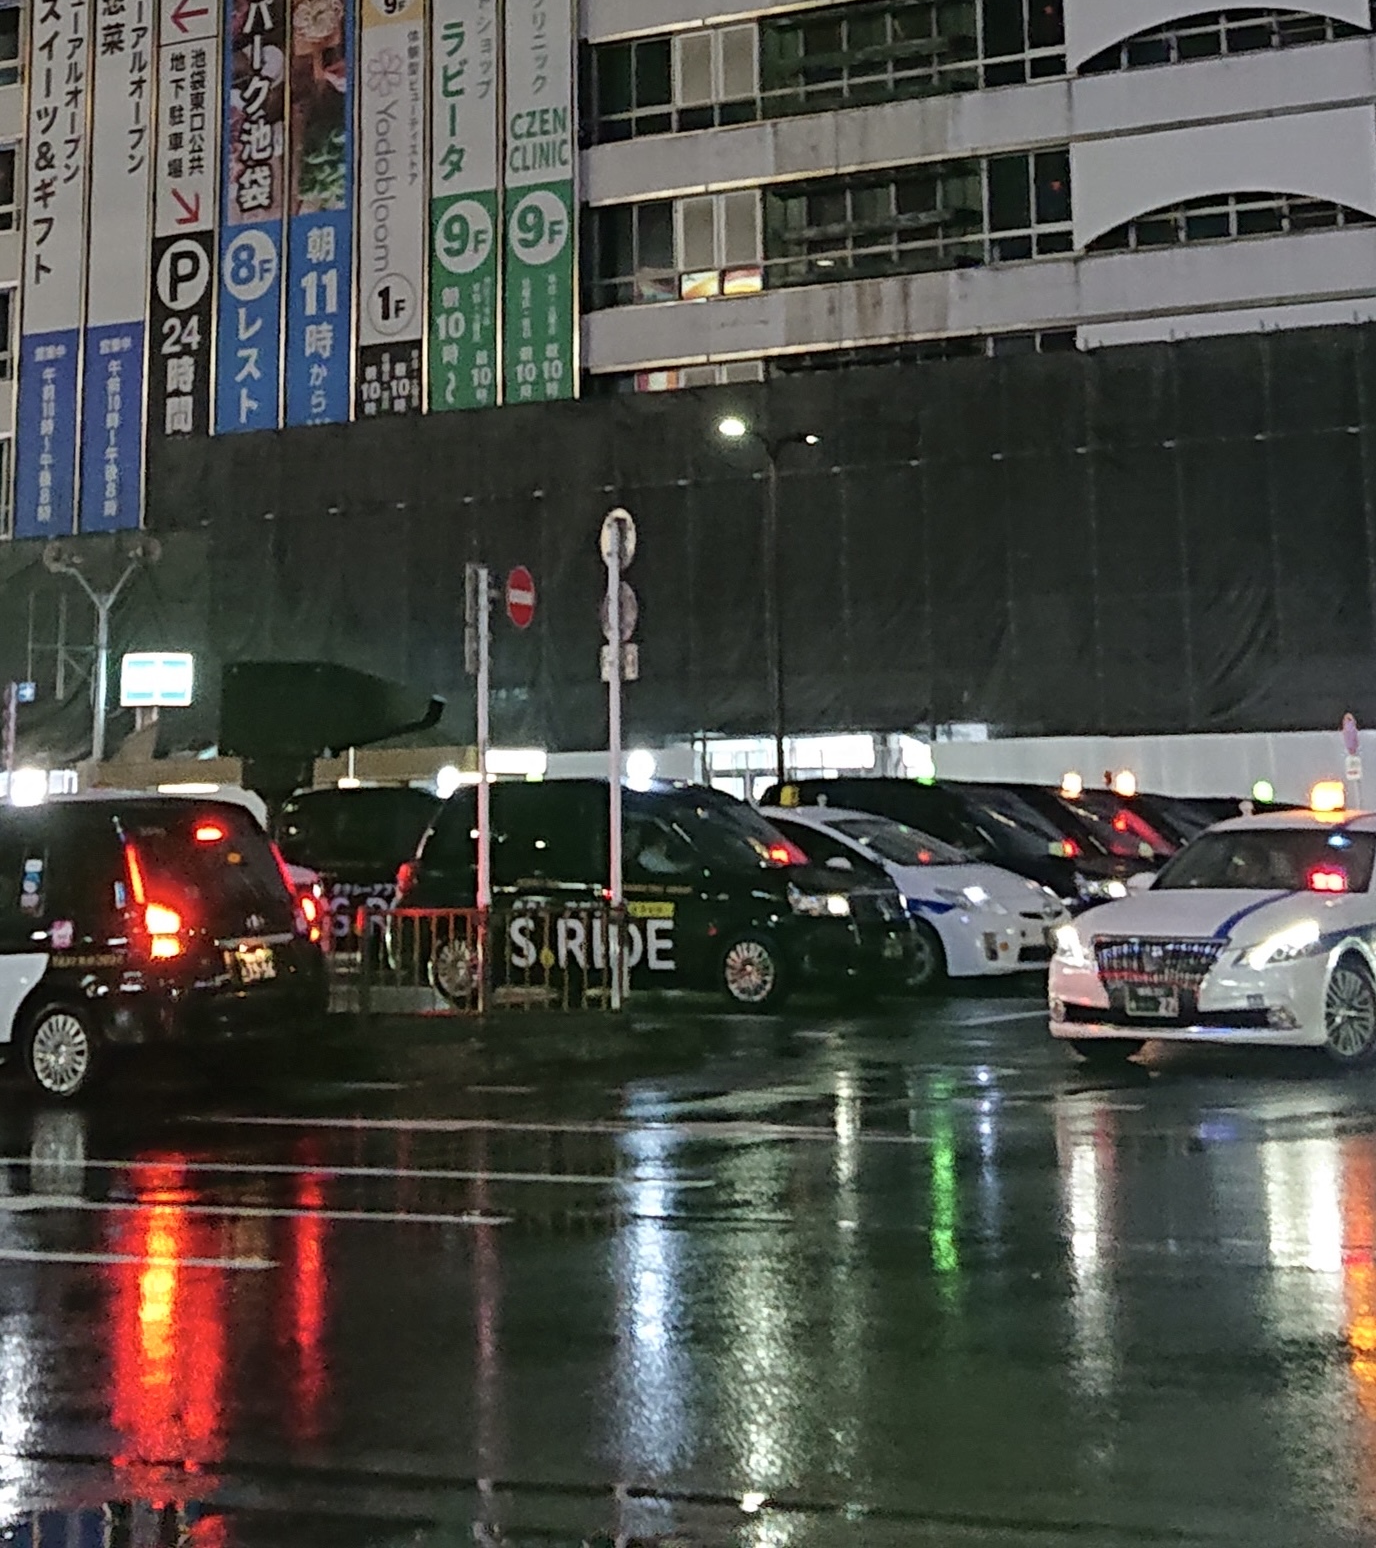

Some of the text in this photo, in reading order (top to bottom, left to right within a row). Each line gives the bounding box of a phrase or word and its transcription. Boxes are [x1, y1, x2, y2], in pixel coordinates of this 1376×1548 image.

[167, 54, 186, 178] 地下駐車場
[188, 49, 206, 176] 池袋東口公共
[439, 22, 468, 181] ラビータ
[510, 106, 567, 140] CZEN
[509, 139, 569, 173] CLINIC
[372, 100, 398, 273] Yodobloom
[443, 214, 488, 257] 9F
[517, 204, 564, 248] 9F
[169, 251, 200, 302] P
[230, 244, 273, 285] 8F
[378, 286, 406, 321] 1F
[161, 314, 202, 437] 24時間
